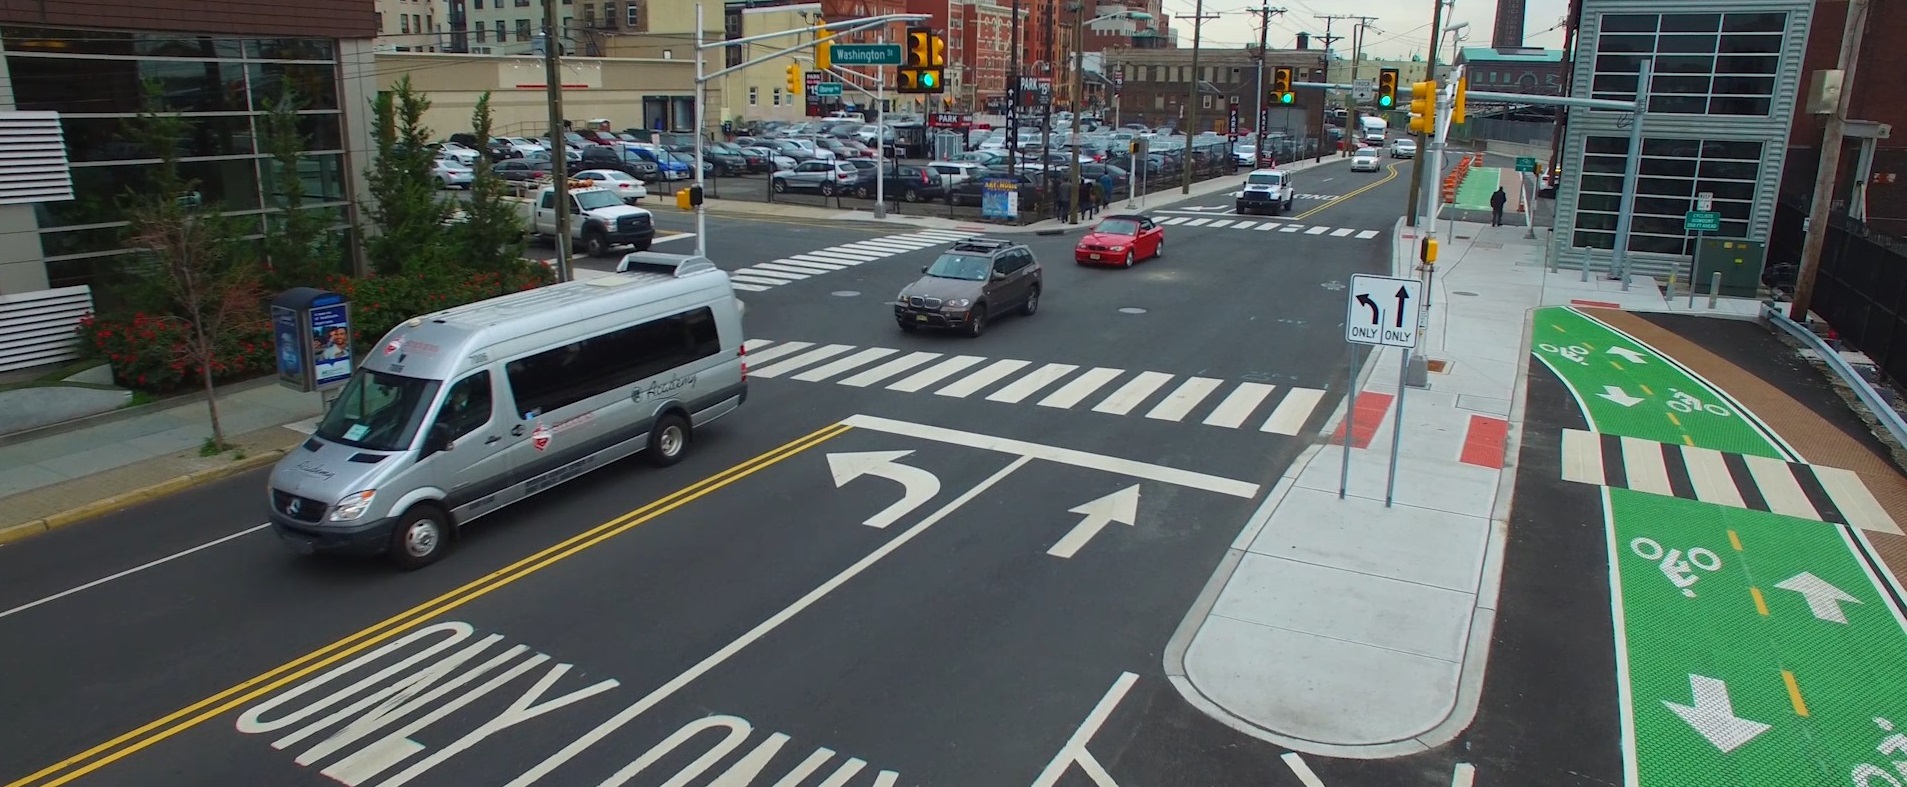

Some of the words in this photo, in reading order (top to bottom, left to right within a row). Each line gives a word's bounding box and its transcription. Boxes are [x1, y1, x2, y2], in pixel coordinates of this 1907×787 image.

[837, 49, 886, 63] Washington
[1021, 78, 1038, 91] PARK
[938, 114, 958, 123] PARK
[1352, 327, 1378, 339] ONLY
[1385, 330, 1411, 342] ONLY
[645, 374, 697, 399] Academy
[236, 621, 621, 787] ONLY
